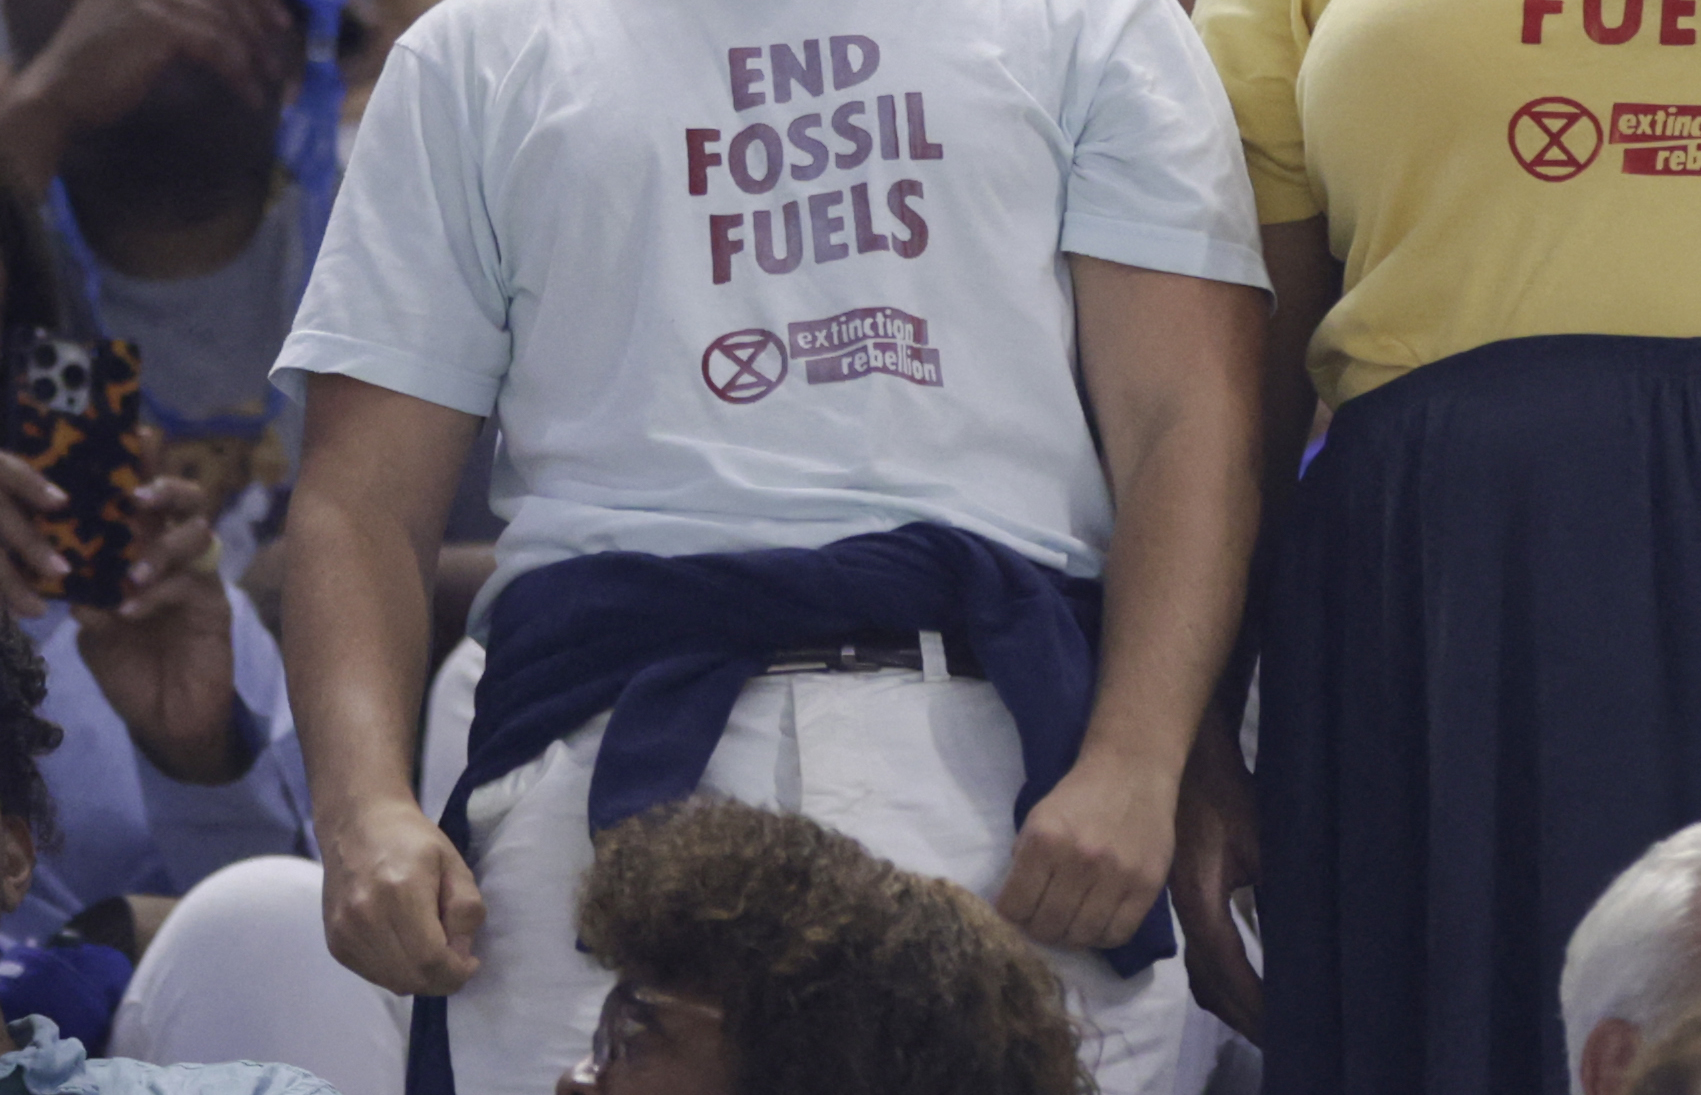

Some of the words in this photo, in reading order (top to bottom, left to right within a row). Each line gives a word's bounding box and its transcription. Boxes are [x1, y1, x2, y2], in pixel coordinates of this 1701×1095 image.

[728, 34, 880, 112] END
[685, 91, 943, 196] FOSSIL
[709, 179, 929, 285] FUELS
[797, 307, 914, 350] extinction
[840, 342, 938, 383] rebellion
